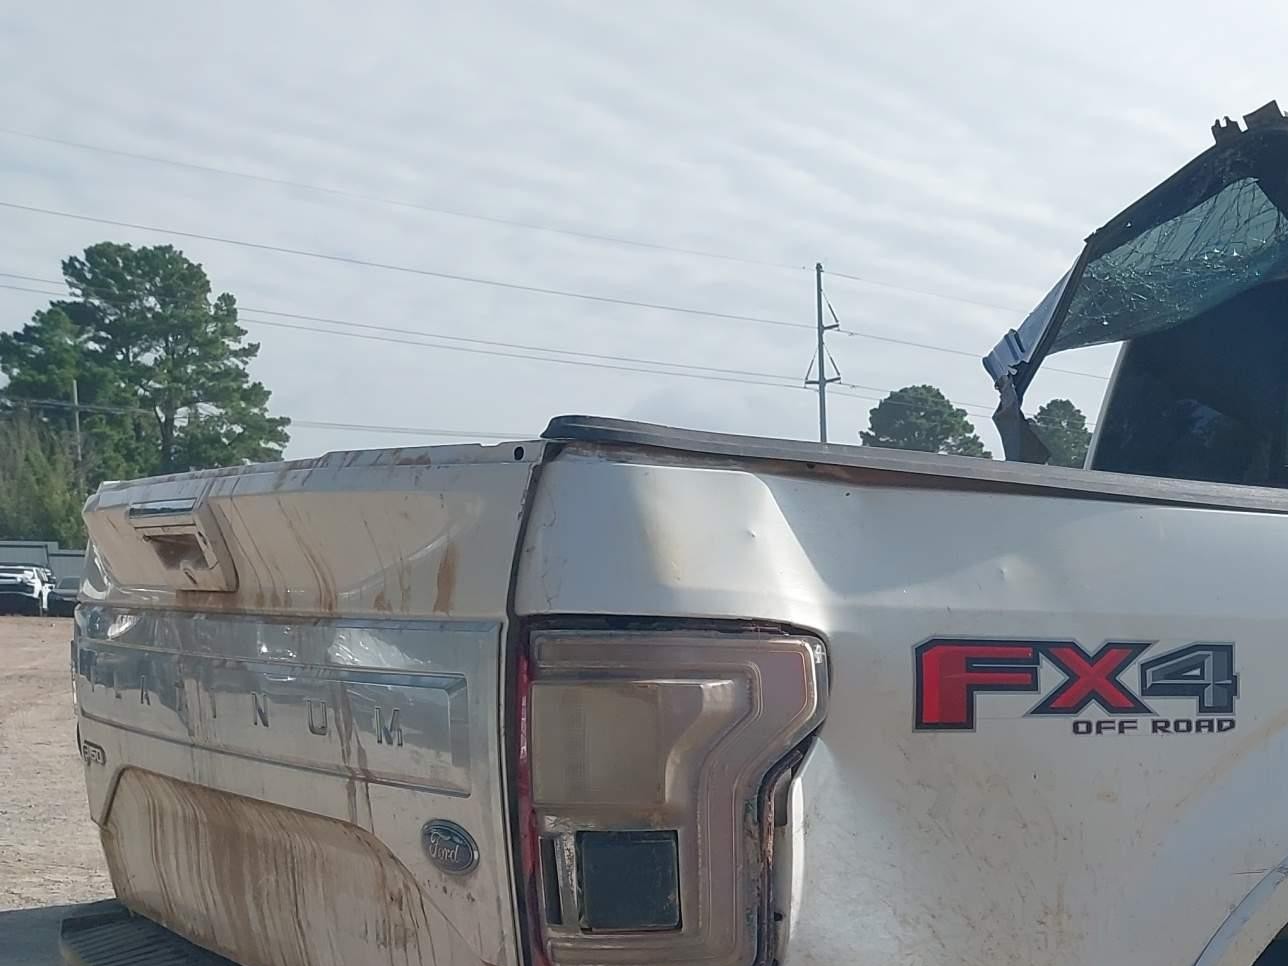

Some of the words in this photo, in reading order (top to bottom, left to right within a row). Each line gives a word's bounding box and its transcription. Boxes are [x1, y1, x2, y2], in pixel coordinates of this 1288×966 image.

[912, 635, 1240, 733] FX4
[1071, 719, 1138, 735] OFF
[1151, 718, 1236, 734] ROAD
[429, 831, 460, 863] Ford
